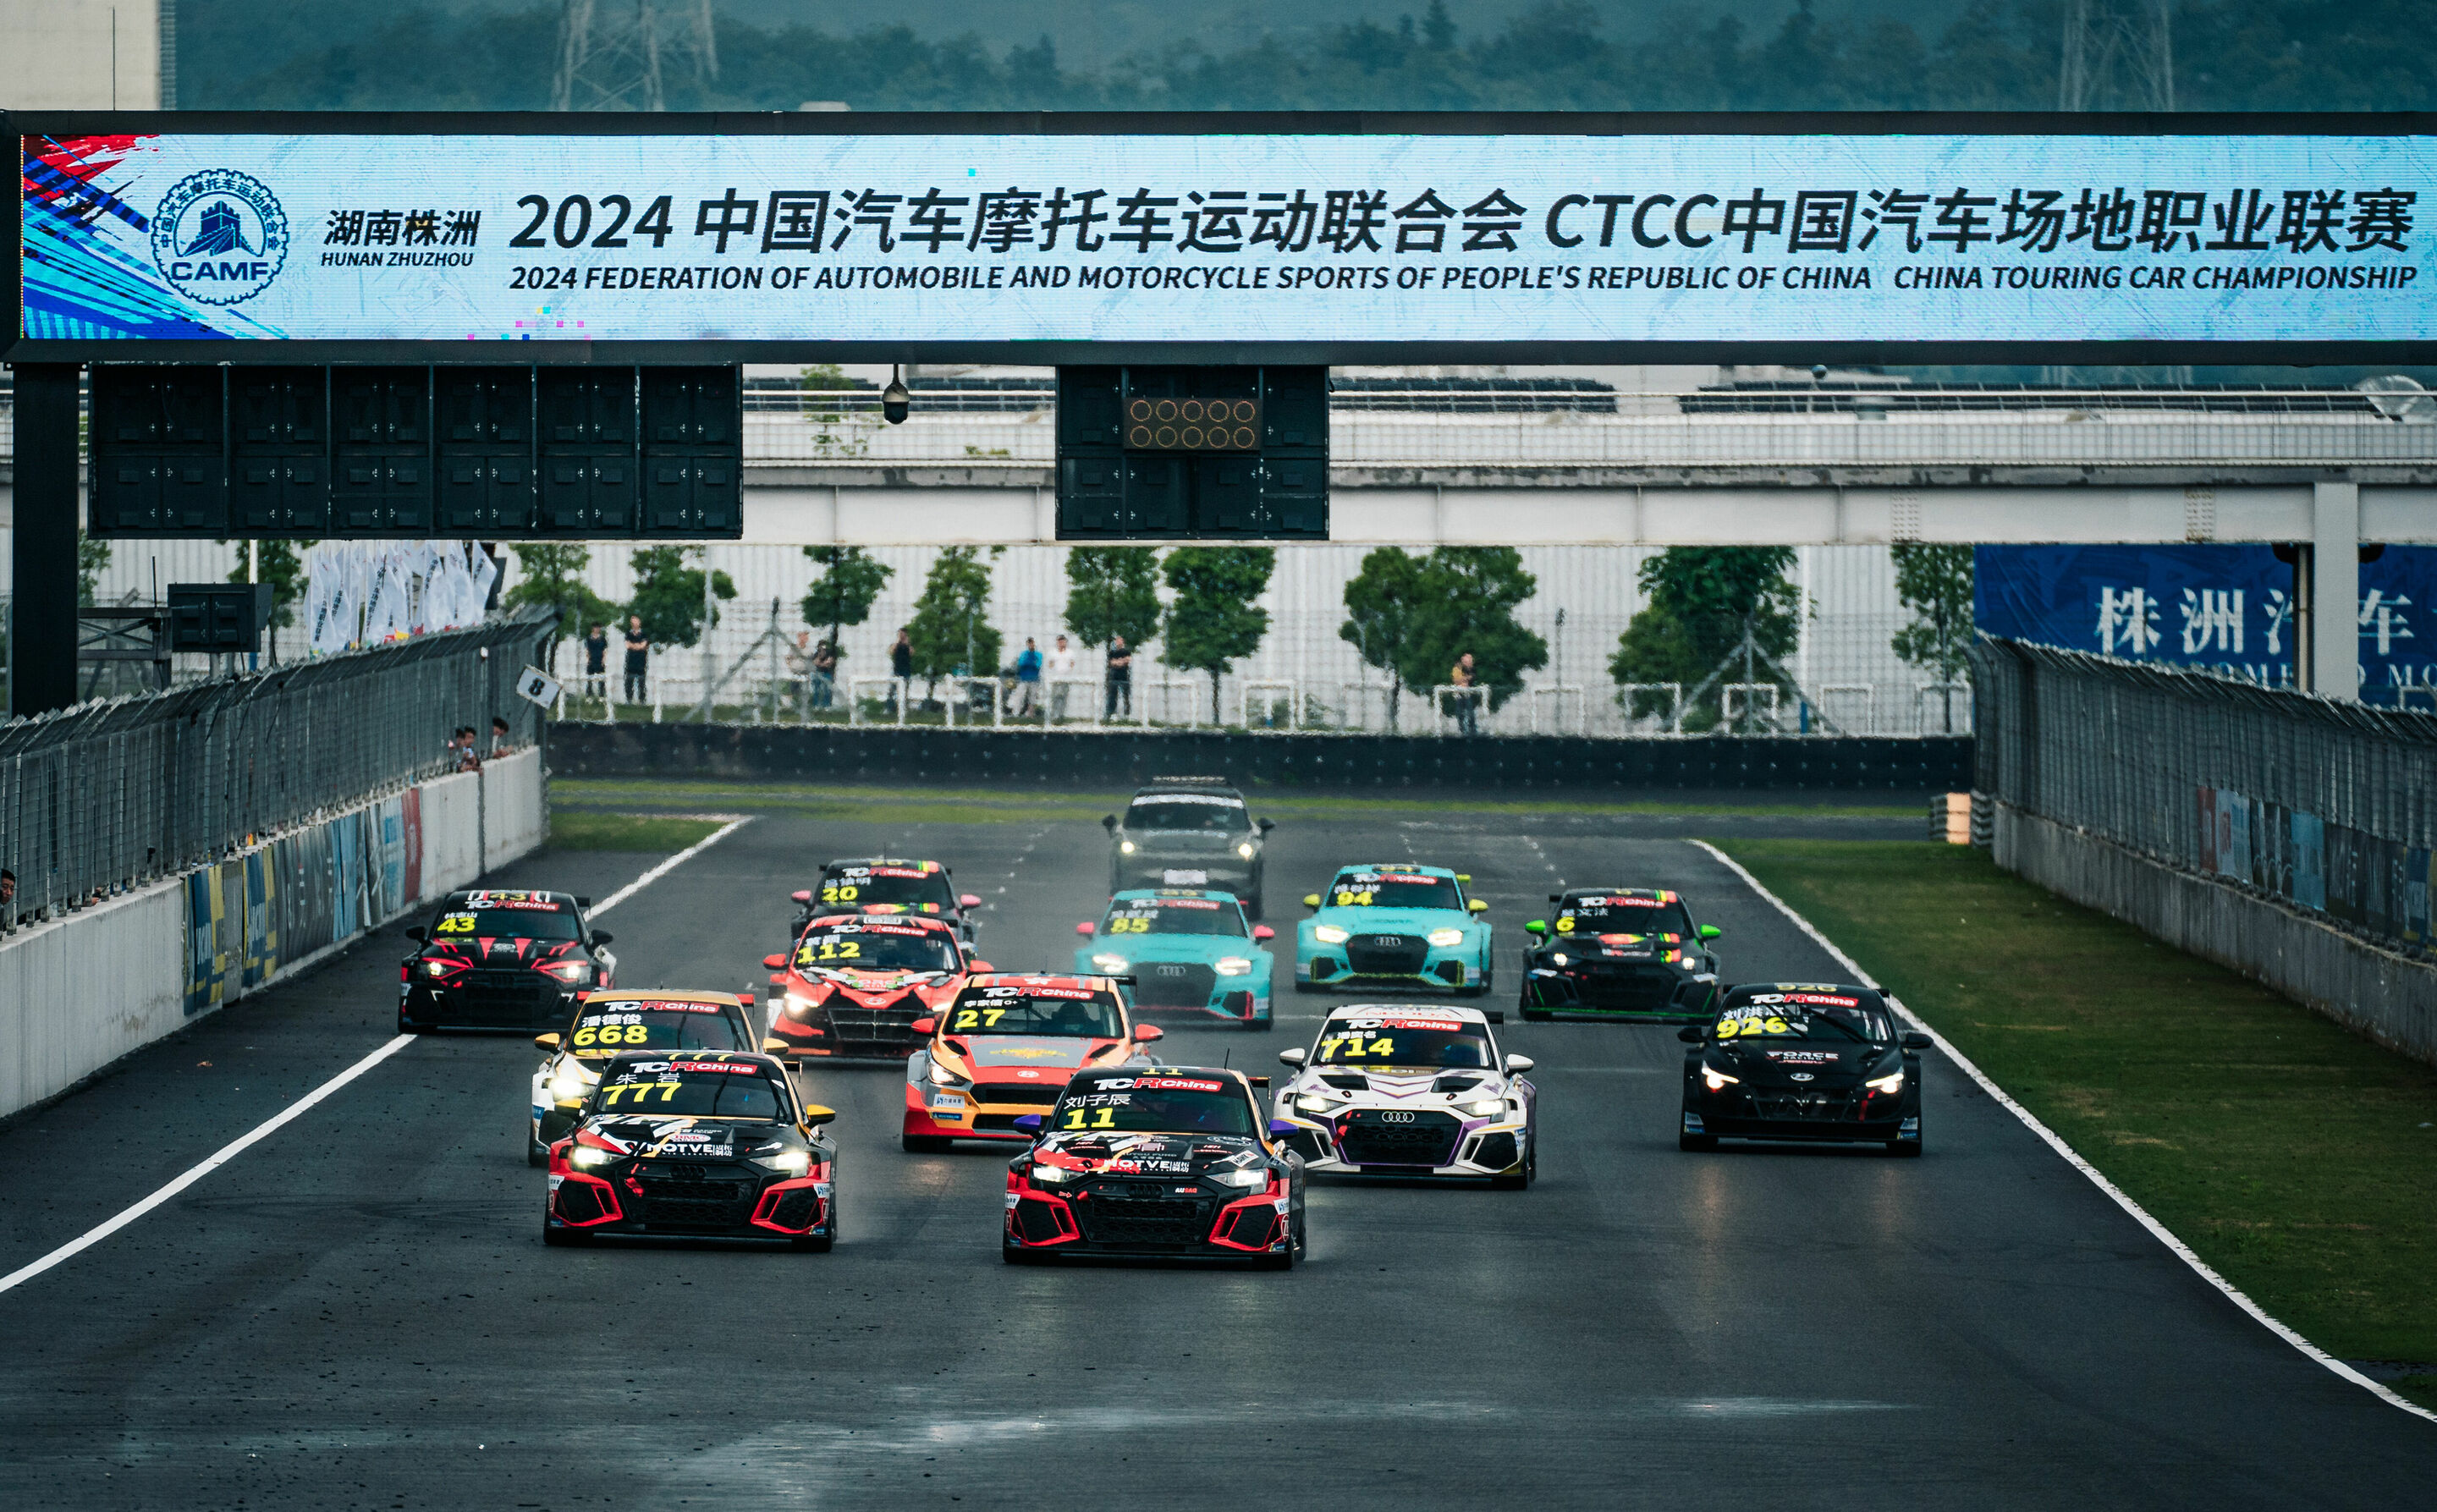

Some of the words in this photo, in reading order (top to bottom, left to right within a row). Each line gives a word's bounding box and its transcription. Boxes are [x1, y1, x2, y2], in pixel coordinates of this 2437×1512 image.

[323, 209, 481, 247] 湖南株洲
[509, 194, 673, 249] 2024
[694, 186, 1527, 254] 中国汽车摩托车运动联合会
[321, 252, 383, 267] HUNAN
[387, 252, 474, 267] ZHUZHOU
[171, 261, 269, 281] CAMF
[509, 266, 578, 289] 2024
[585, 266, 764, 289] FEDERATION
[771, 266, 811, 289] OF
[814, 266, 1004, 289] AUTOMOBILE
[1009, 266, 1071, 289] AND
[1078, 266, 1270, 289] MOTORCYCLE
[1275, 266, 1391, 289] SPORTS
[1396, 266, 1437, 289] OF
[1442, 266, 1582, 289] PEOPLE'S
[1587, 266, 1730, 289] REPUBLIC
[1737, 266, 1777, 289] OF
[1783, 266, 1871, 289] CHINA
[1894, 266, 1983, 289] CHINA
[1991, 266, 2122, 289] TOURING
[2129, 266, 2187, 289] CAR
[2192, 266, 2418, 289] CHAMPIONSHIP
[528, 678, 546, 696] 8
[490, 893, 526, 901] 43
[822, 886, 858, 902] 20
[437, 917, 476, 932] 43
[1556, 916, 1575, 932] 6
[797, 942, 861, 964] 112
[954, 1009, 1006, 1029] 27
[1717, 1017, 1788, 1039] 926
[574, 1025, 648, 1046] 668
[1321, 1038, 1395, 1059] 714
[1142, 1067, 1183, 1075] 11
[602, 1082, 682, 1106] 777
[1064, 1093, 1132, 1109] 刘子辰
[1064, 1108, 1115, 1130] 11
